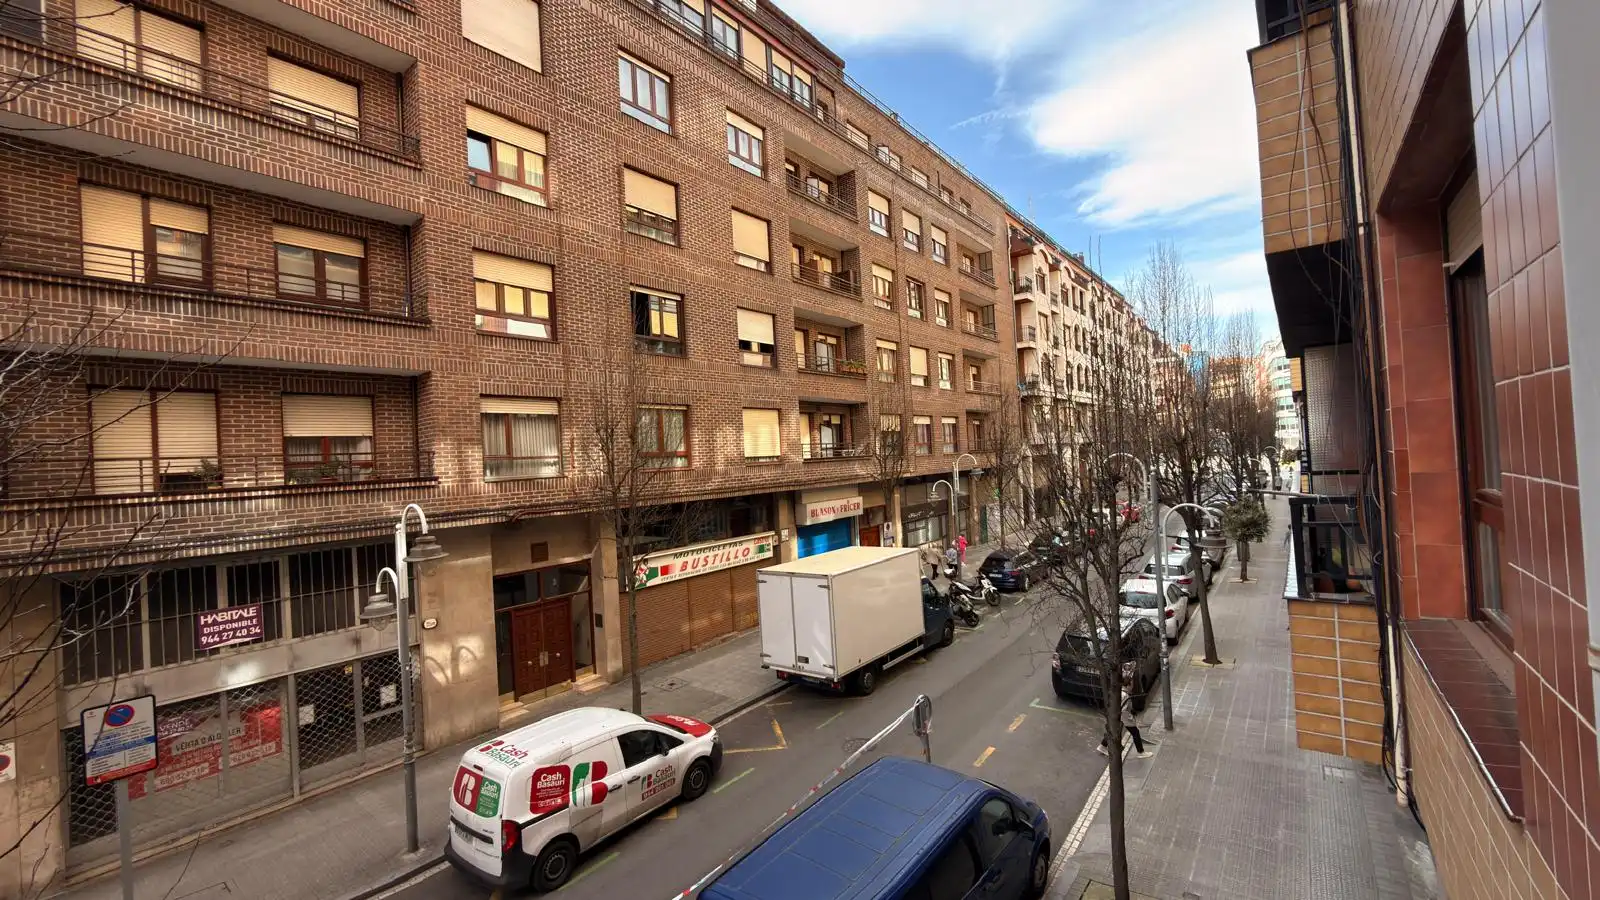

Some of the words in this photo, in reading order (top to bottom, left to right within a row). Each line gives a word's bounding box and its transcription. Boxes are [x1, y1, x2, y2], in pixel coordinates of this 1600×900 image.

[673, 542, 743, 560] MOTOCICLETAS
[679, 547, 751, 572] BUSTILLO
[200, 606, 257, 625] HABITALE
[203, 618, 258, 634] DISPONIBLE
[201, 634, 220, 645] 944
[222, 631, 233, 640] 27
[235, 628, 248, 637] 40
[249, 626, 261, 635] 34
[500, 744, 529, 760] Cash
[540, 771, 562, 782] Cash
[656, 764, 673, 778] Cash
[536, 777, 565, 789] Basauri
